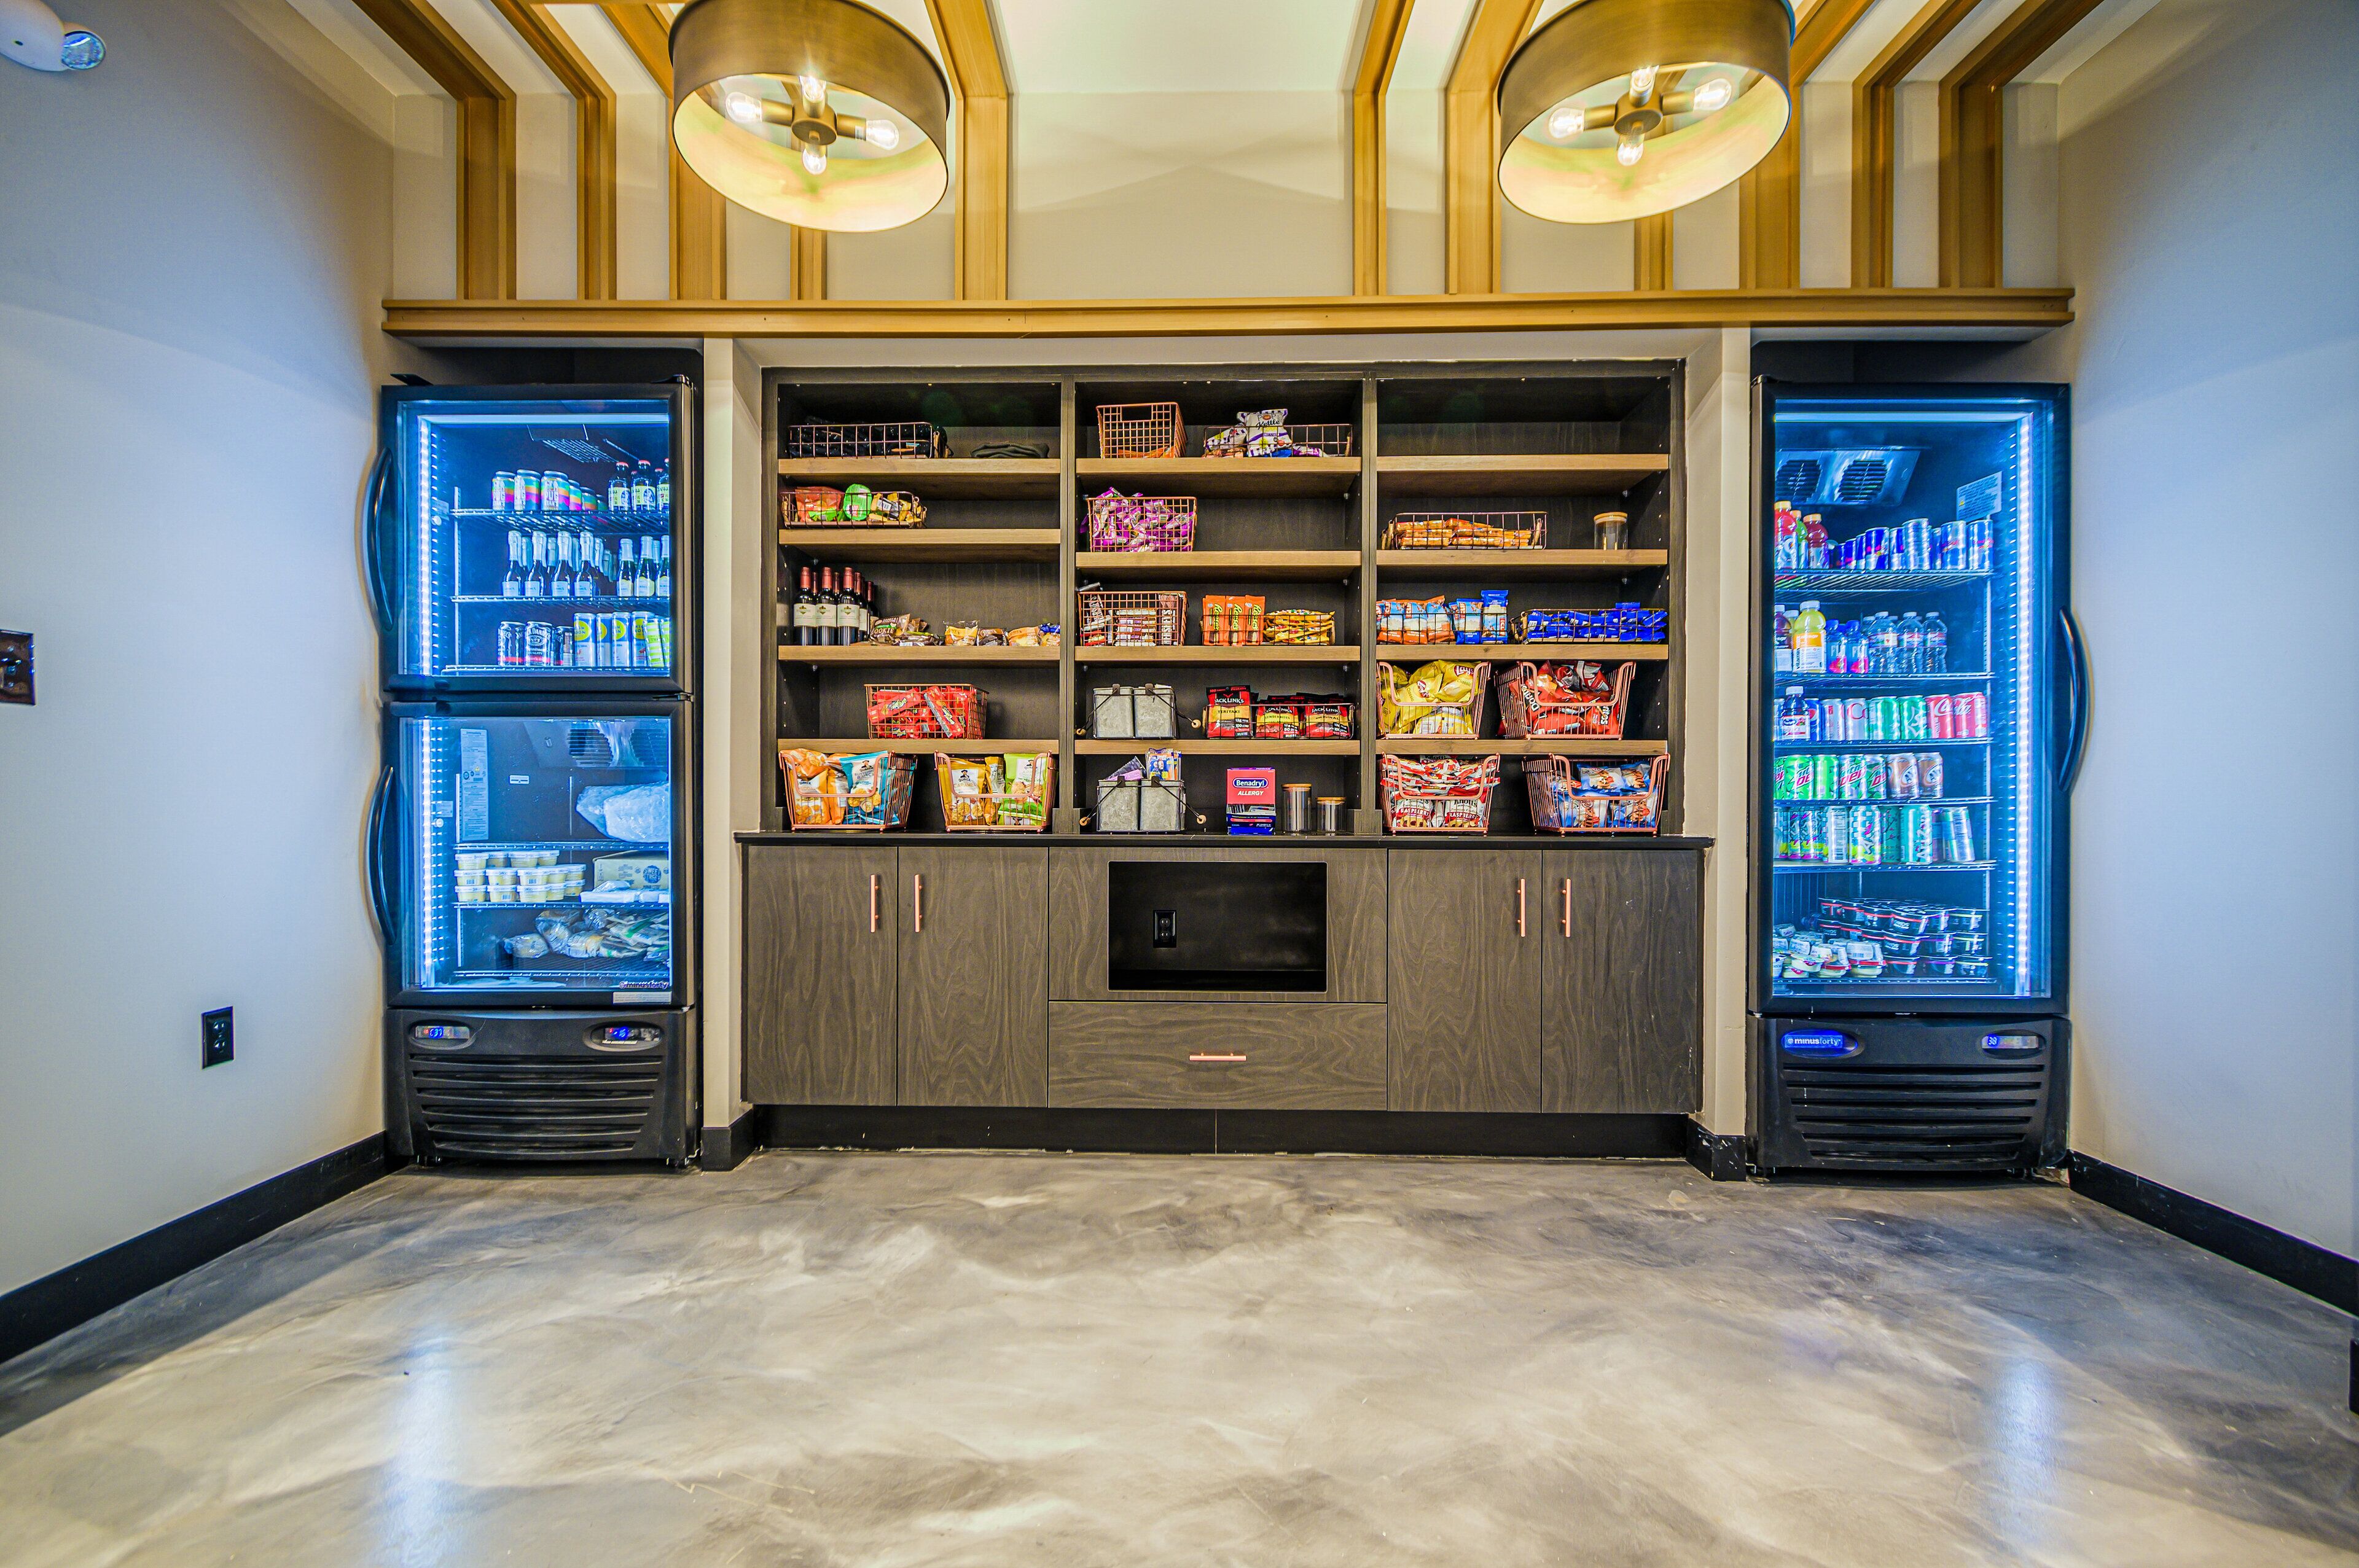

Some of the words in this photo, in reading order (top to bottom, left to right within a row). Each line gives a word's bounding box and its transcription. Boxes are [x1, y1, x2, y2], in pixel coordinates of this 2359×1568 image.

[1256, 420, 1280, 429] Kettle
[1456, 665, 1474, 675] Lay's
[1406, 687, 1415, 701] Classic
[1600, 706, 1610, 725] ritos
[1794, 1037, 1838, 1046] minusforty
